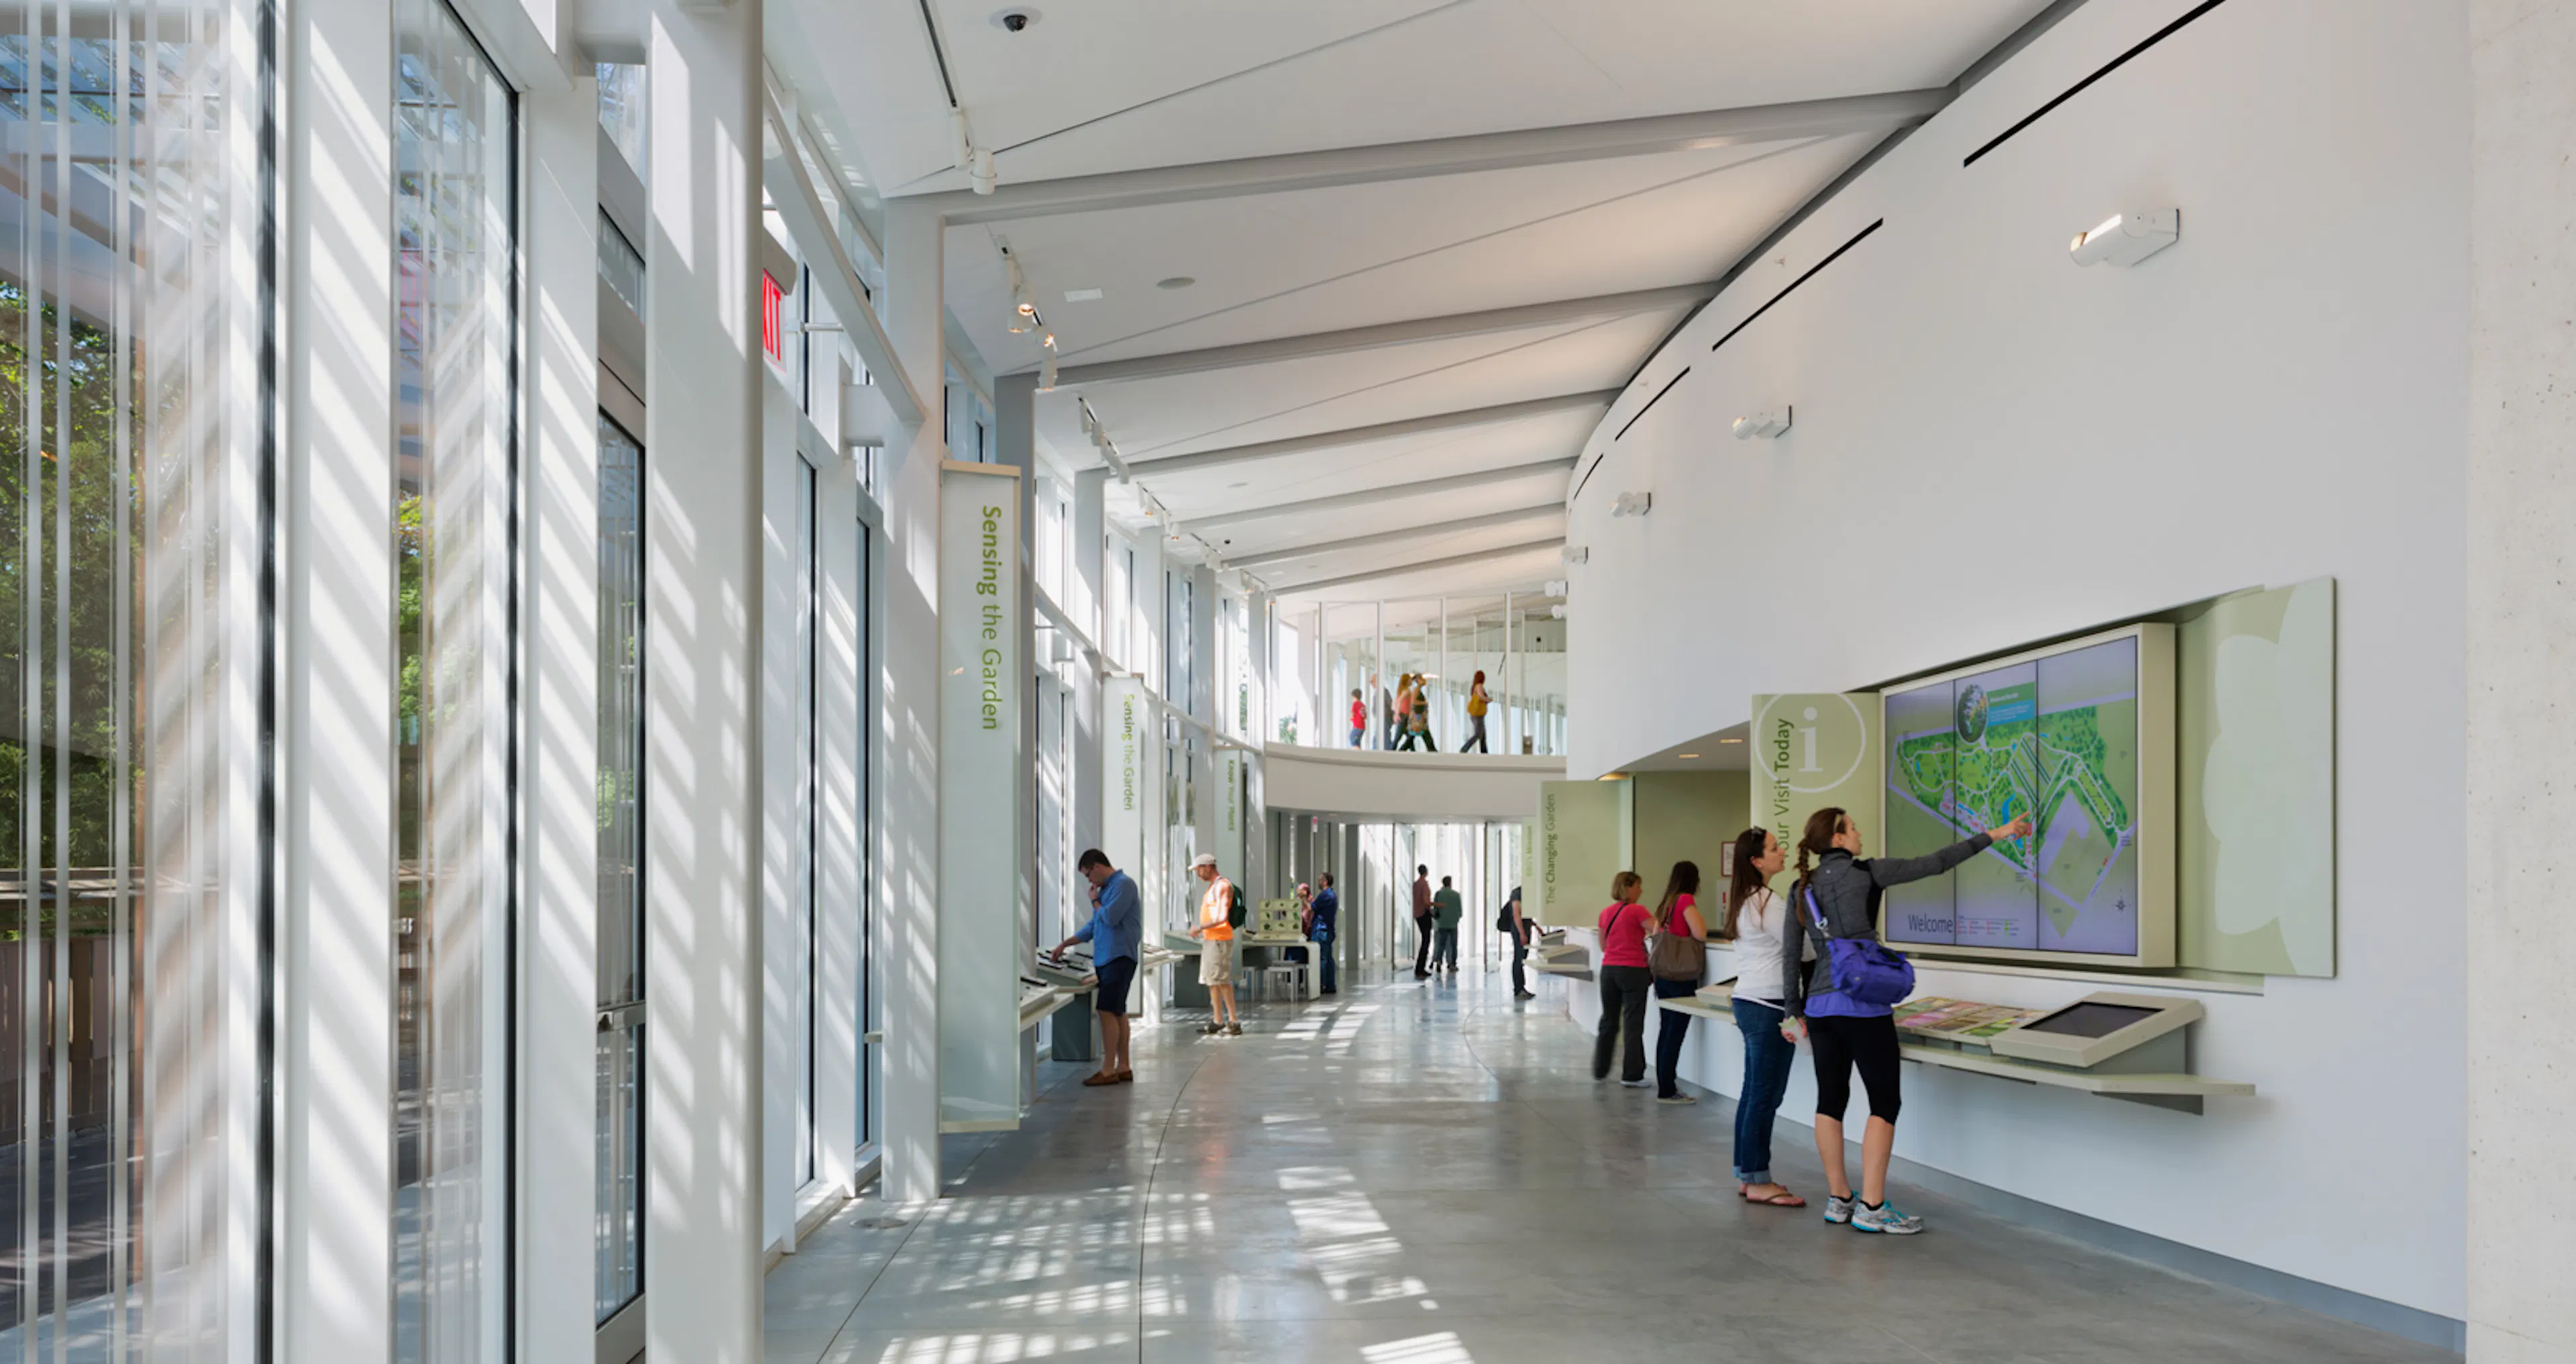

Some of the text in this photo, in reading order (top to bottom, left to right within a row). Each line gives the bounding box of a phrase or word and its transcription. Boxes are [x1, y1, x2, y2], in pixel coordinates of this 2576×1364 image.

[976, 505, 1003, 729] Sensing the Garden
[1121, 693, 1135, 810] Sensing the Garden
[1774, 719, 1794, 857] our Visit Today
[1546, 794, 1558, 904] The Changing Garden
[1908, 913, 1953, 933] Welcome
